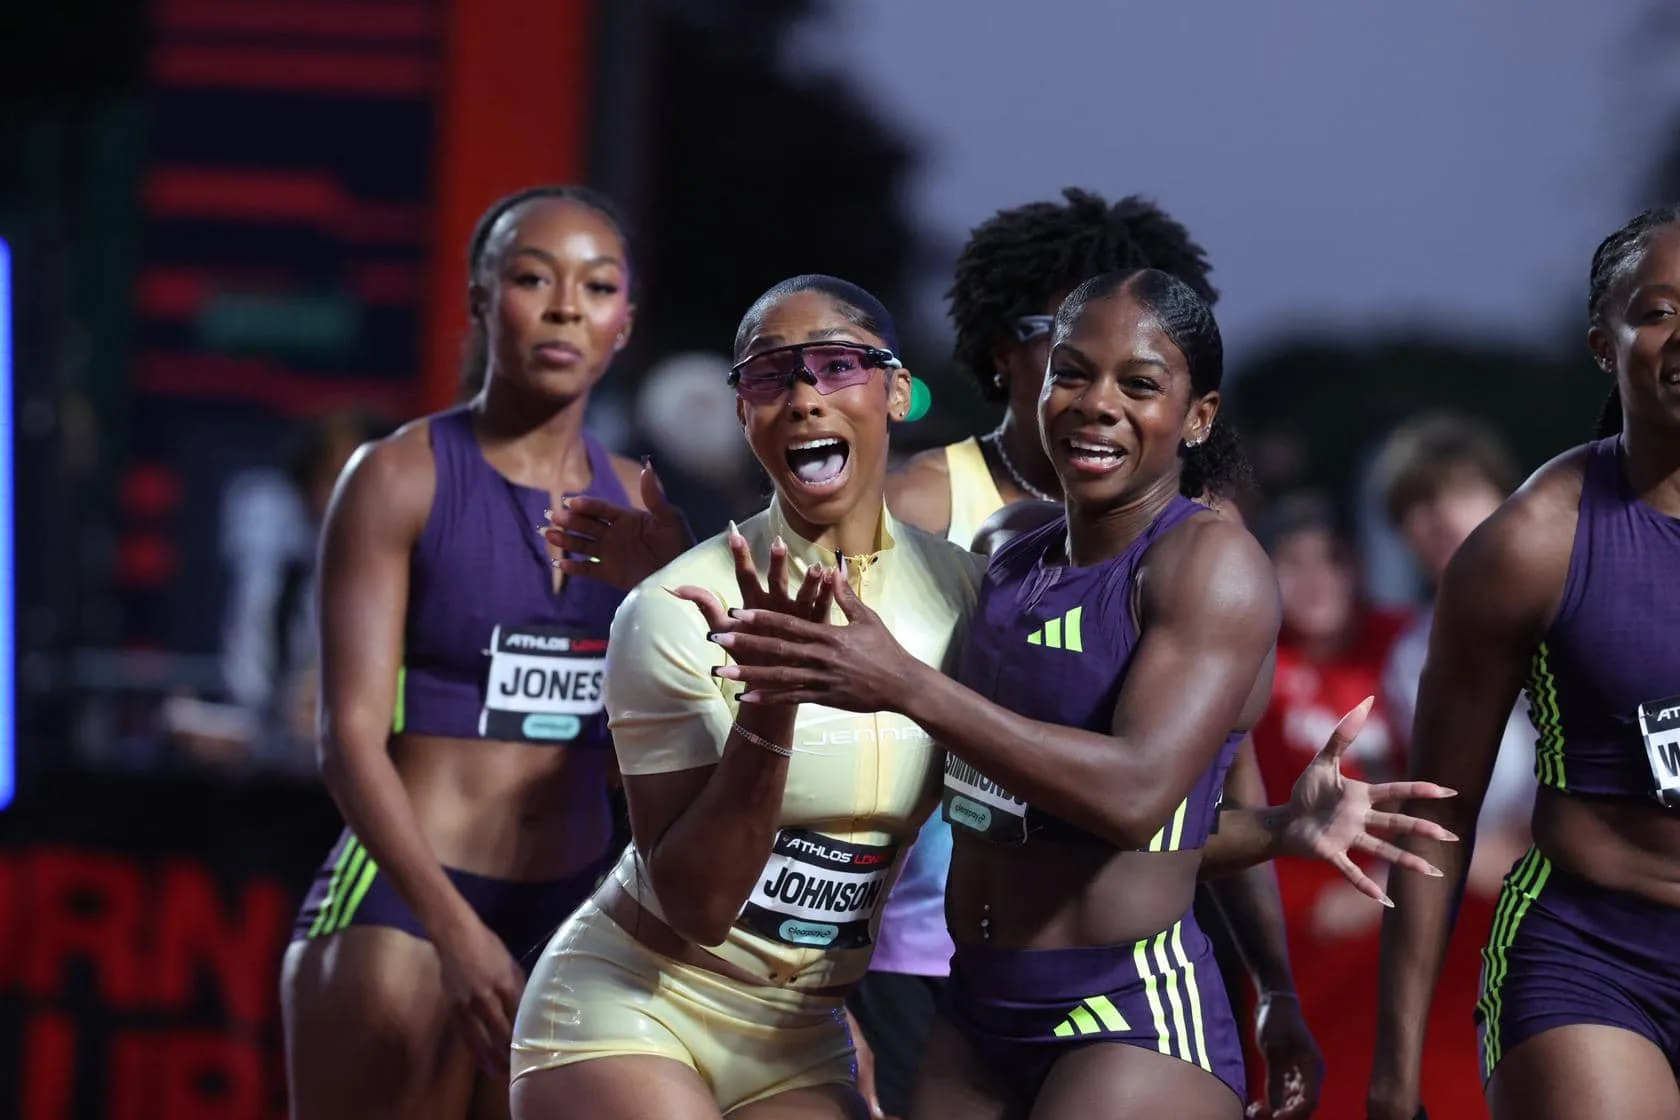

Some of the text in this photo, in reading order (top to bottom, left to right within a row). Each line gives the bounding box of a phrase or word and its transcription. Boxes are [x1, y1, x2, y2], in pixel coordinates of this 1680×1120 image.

[505, 633, 570, 651] ATHLOS
[500, 667, 604, 701] JONES
[1656, 706, 1680, 721] AT
[1657, 742, 1680, 777] W
[786, 838, 853, 864] ATHLOS
[763, 867, 884, 913] JOHNSON
